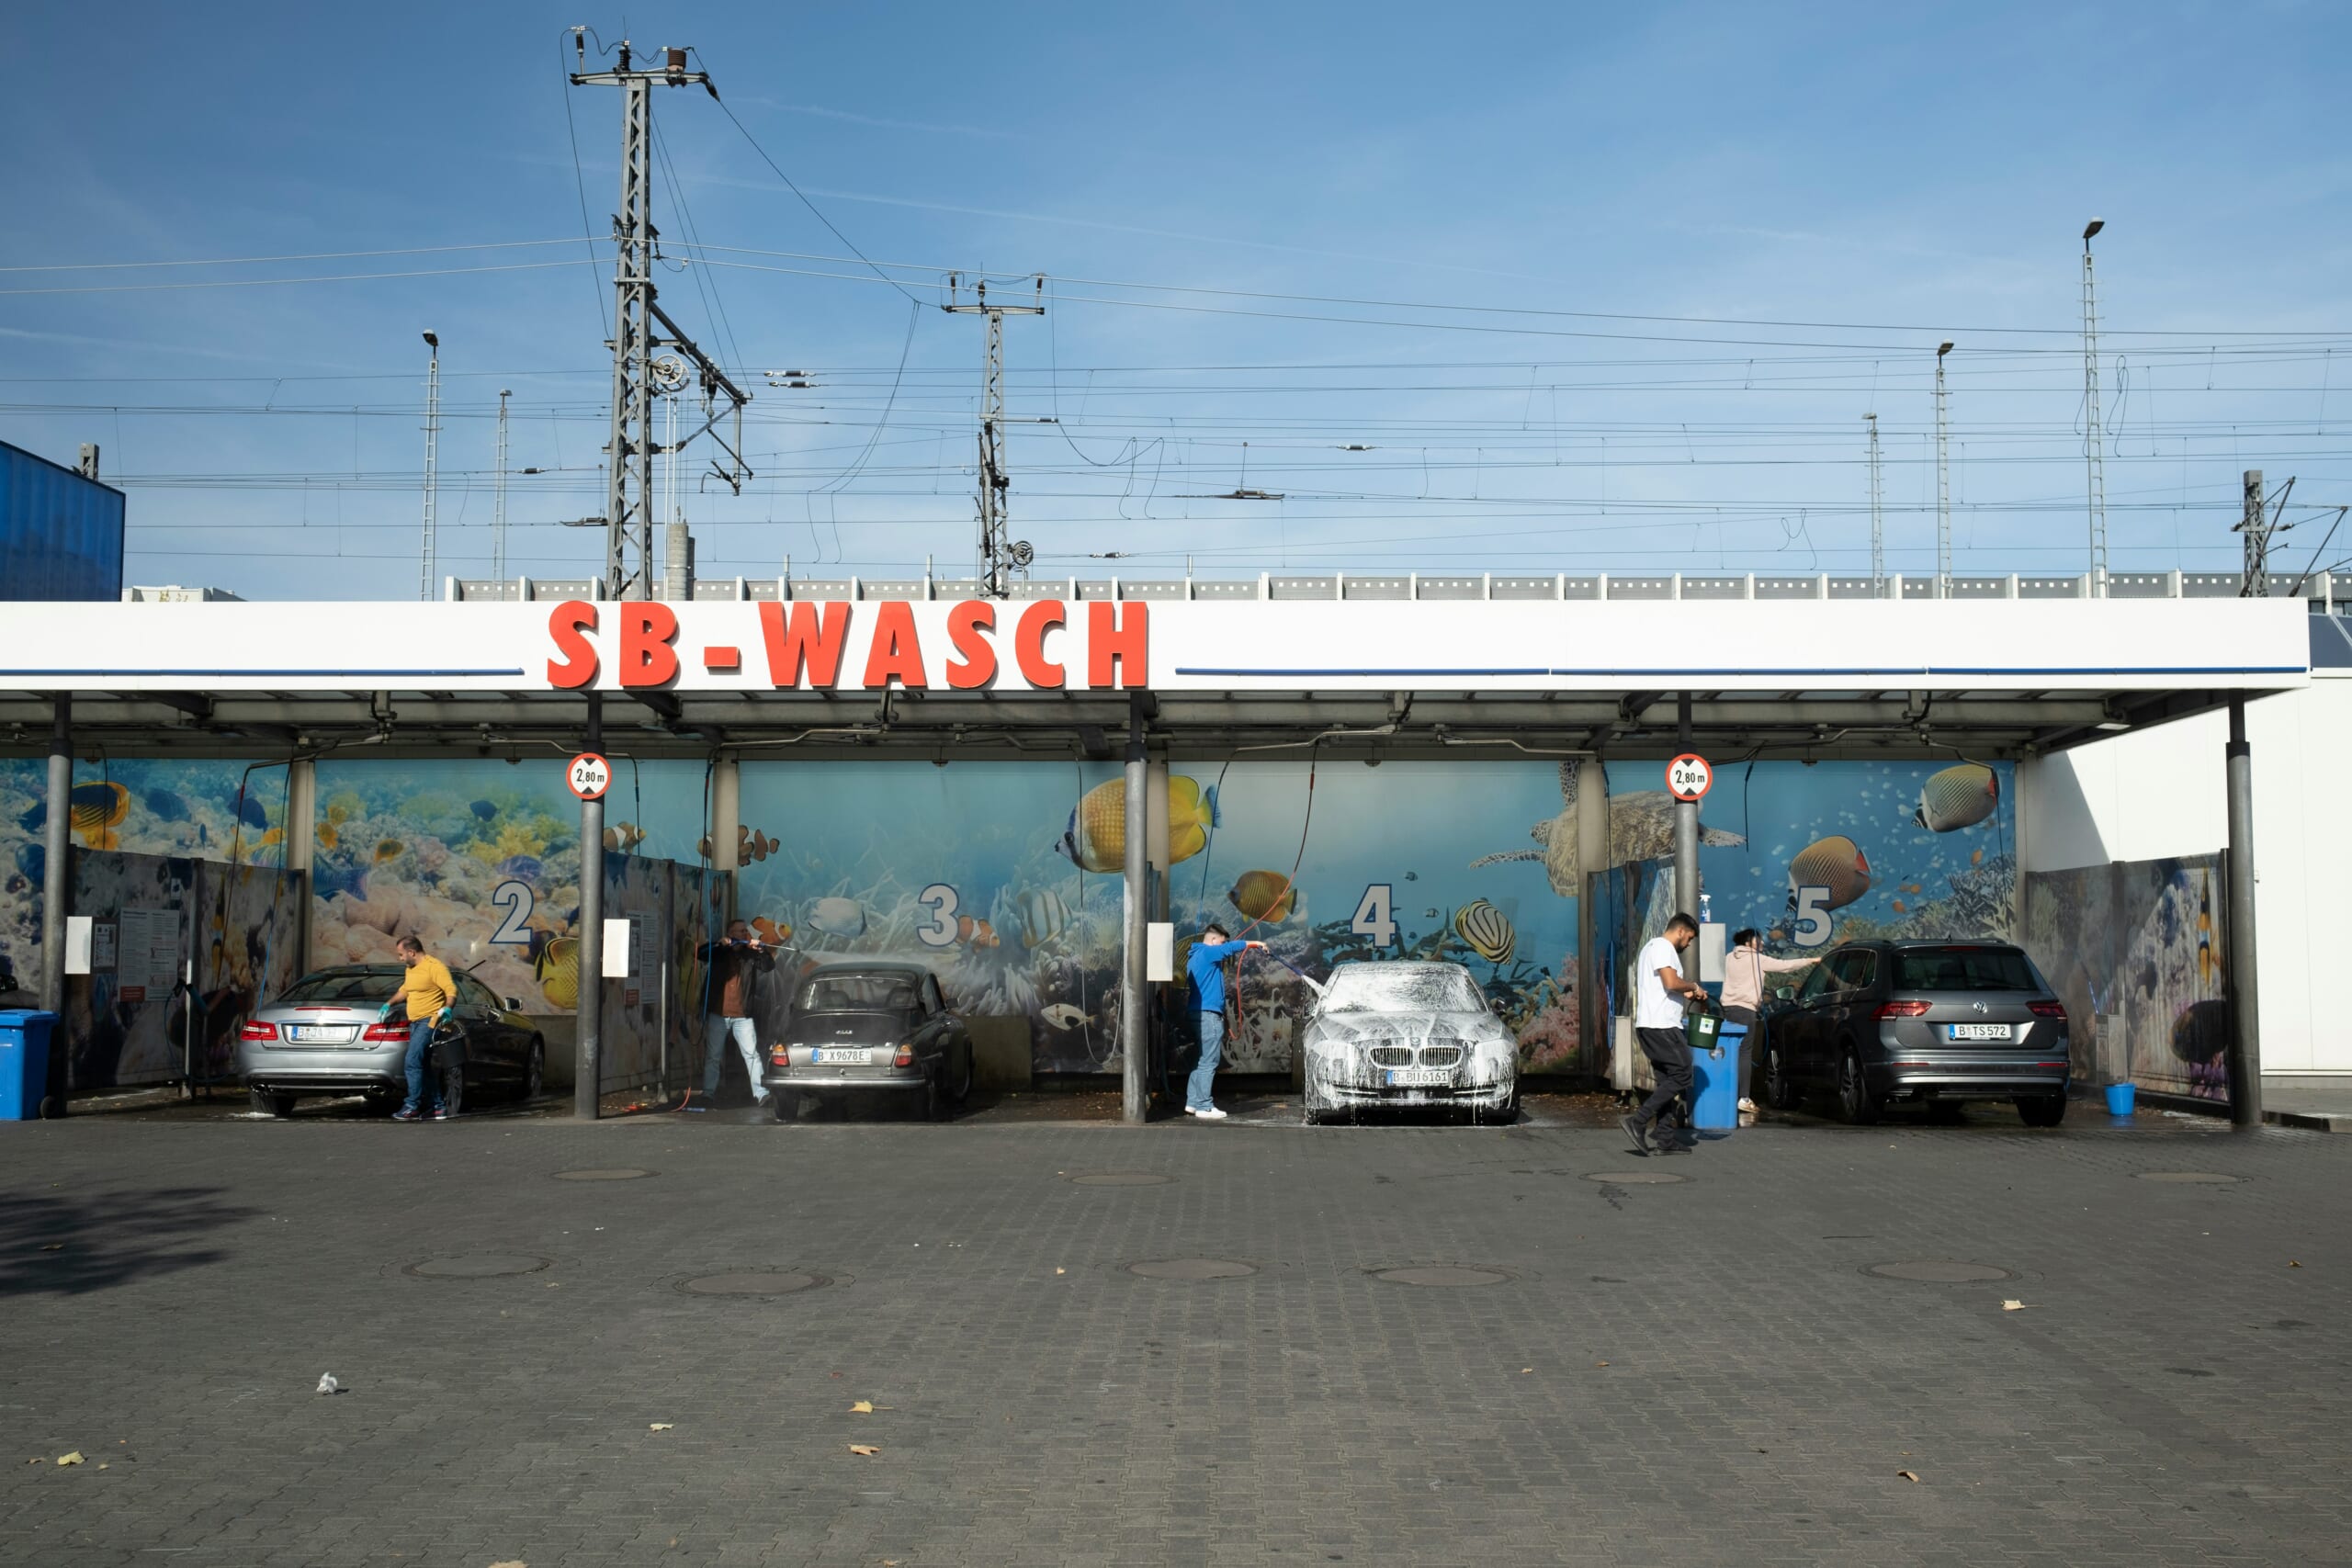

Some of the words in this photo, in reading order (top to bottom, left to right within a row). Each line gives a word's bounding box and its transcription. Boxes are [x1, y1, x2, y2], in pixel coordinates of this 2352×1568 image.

[577, 769, 595, 784] 2,80
[1676, 770, 1695, 784] 2,80
[489, 880, 534, 943] 2
[917, 883, 960, 947] 3
[1350, 884, 1396, 948] 4
[1792, 886, 1834, 949] 5
